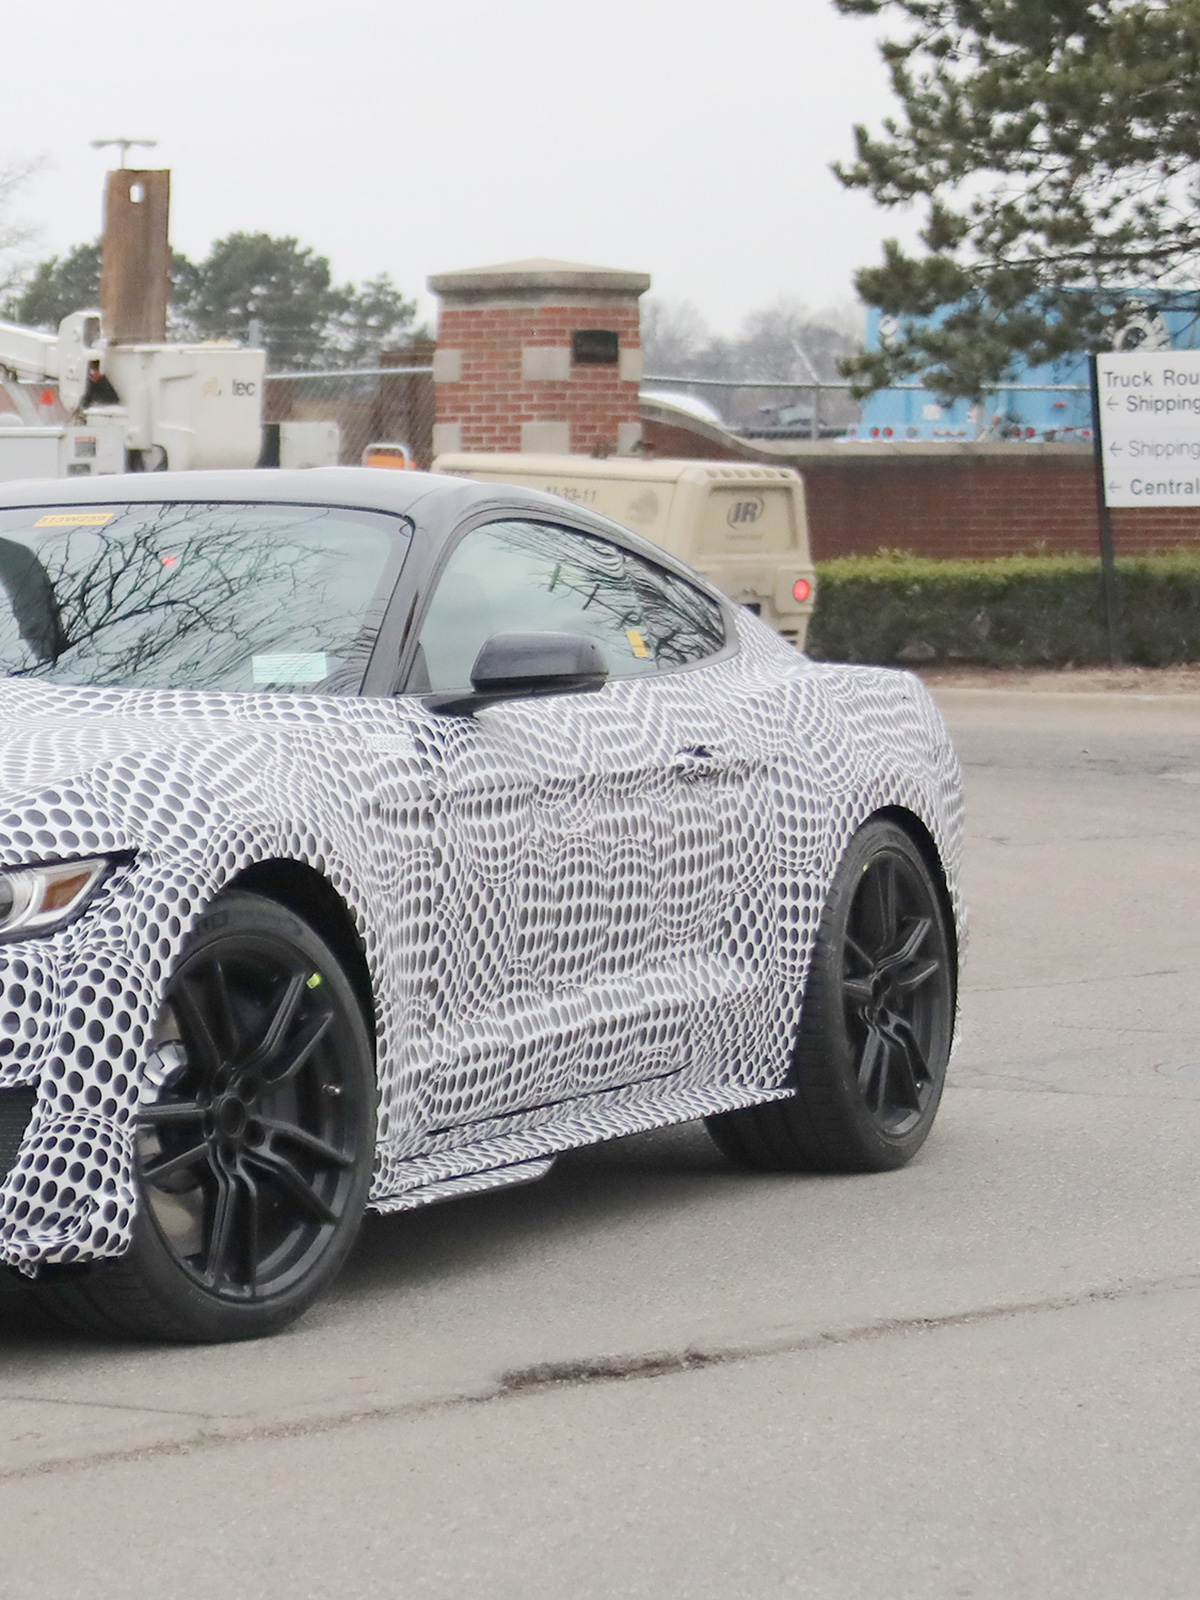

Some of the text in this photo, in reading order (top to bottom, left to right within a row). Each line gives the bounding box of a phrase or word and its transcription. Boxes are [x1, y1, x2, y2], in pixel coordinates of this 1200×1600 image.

[1104, 371, 1153, 388] Truck
[1126, 395, 1200, 415] Shipping
[1128, 440, 1200, 460] Shipping
[1130, 478, 1200, 496] Central
[731, 501, 758, 523] IR
